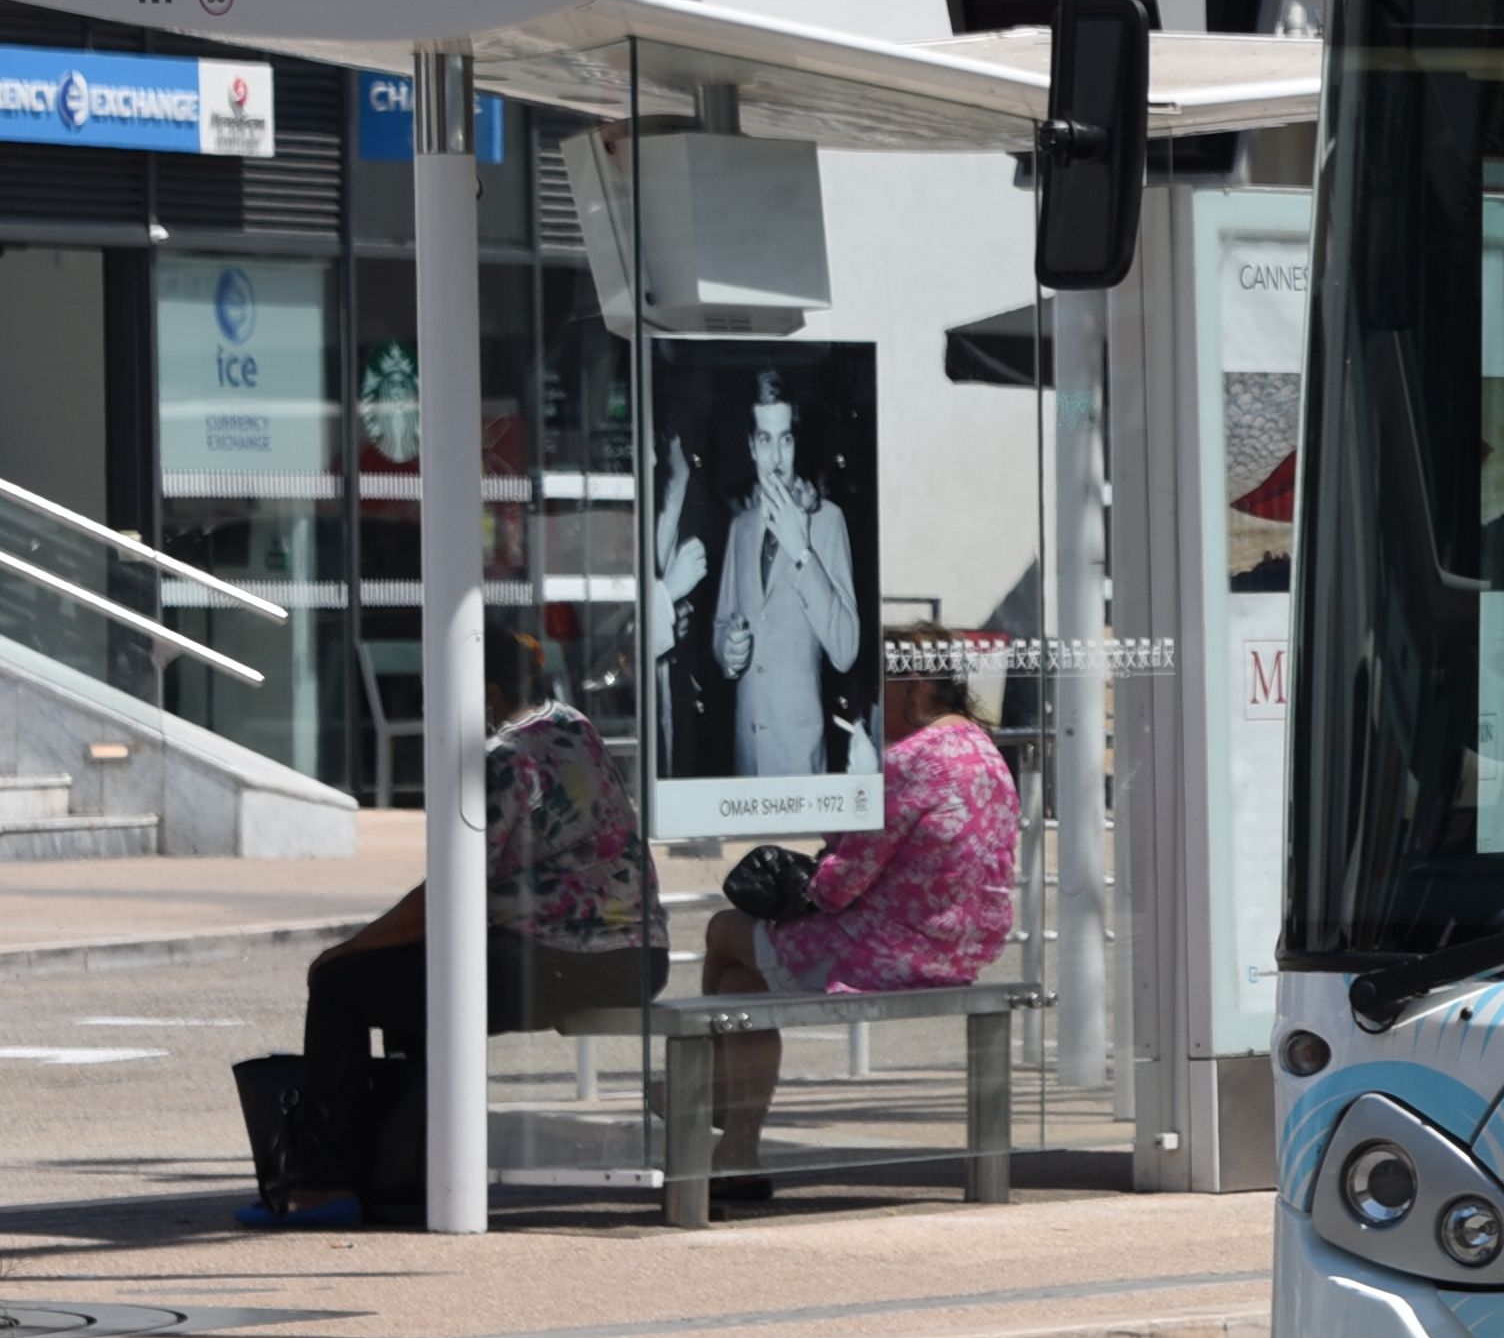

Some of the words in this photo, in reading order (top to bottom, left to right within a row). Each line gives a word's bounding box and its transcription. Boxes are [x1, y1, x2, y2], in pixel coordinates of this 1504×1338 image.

[0, 78, 57, 113] ENCY
[90, 83, 198, 124] EXCHANGE
[216, 343, 258, 388] ice
[720, 799, 759, 817] OMAR
[761, 797, 805, 816] SHARIF
[815, 795, 845, 814] 1972
